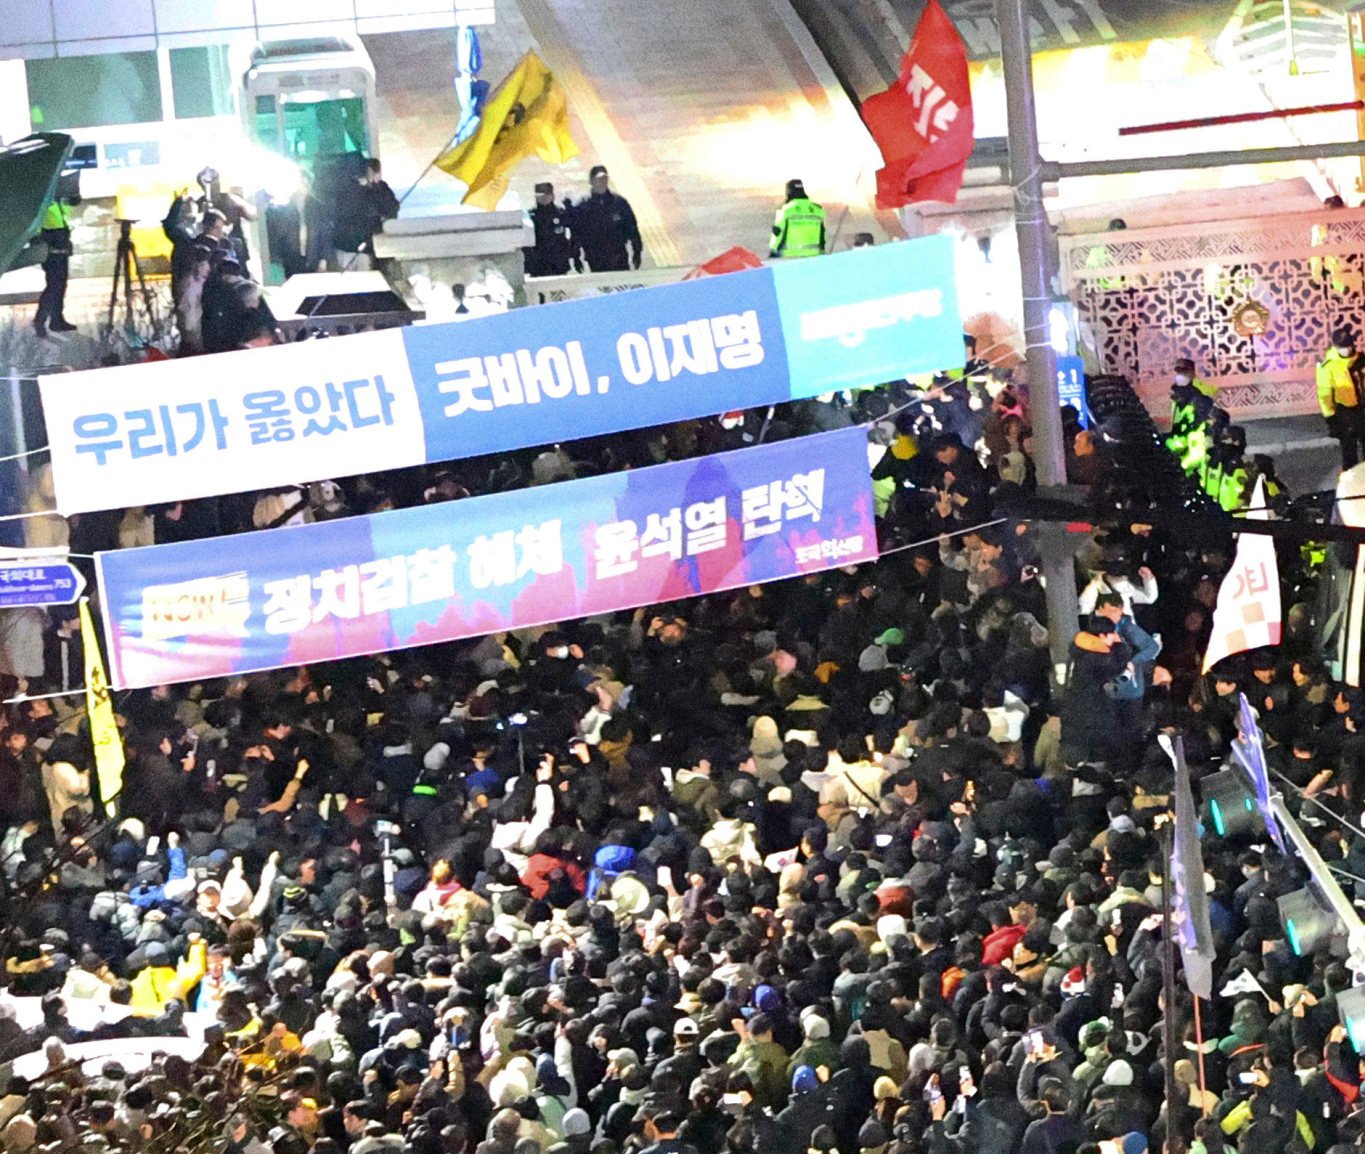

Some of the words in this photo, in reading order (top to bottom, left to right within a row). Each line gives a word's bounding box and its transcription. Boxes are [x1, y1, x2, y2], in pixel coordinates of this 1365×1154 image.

[73, 398, 229, 466] 우리가
[243, 375, 396, 445] 옳았다
[435, 340, 610, 418] 굿바이,
[616, 310, 765, 385] 이재명
[263, 545, 458, 636] 정치검찰
[467, 519, 563, 589] 해체
[594, 496, 727, 580] 윤석열
